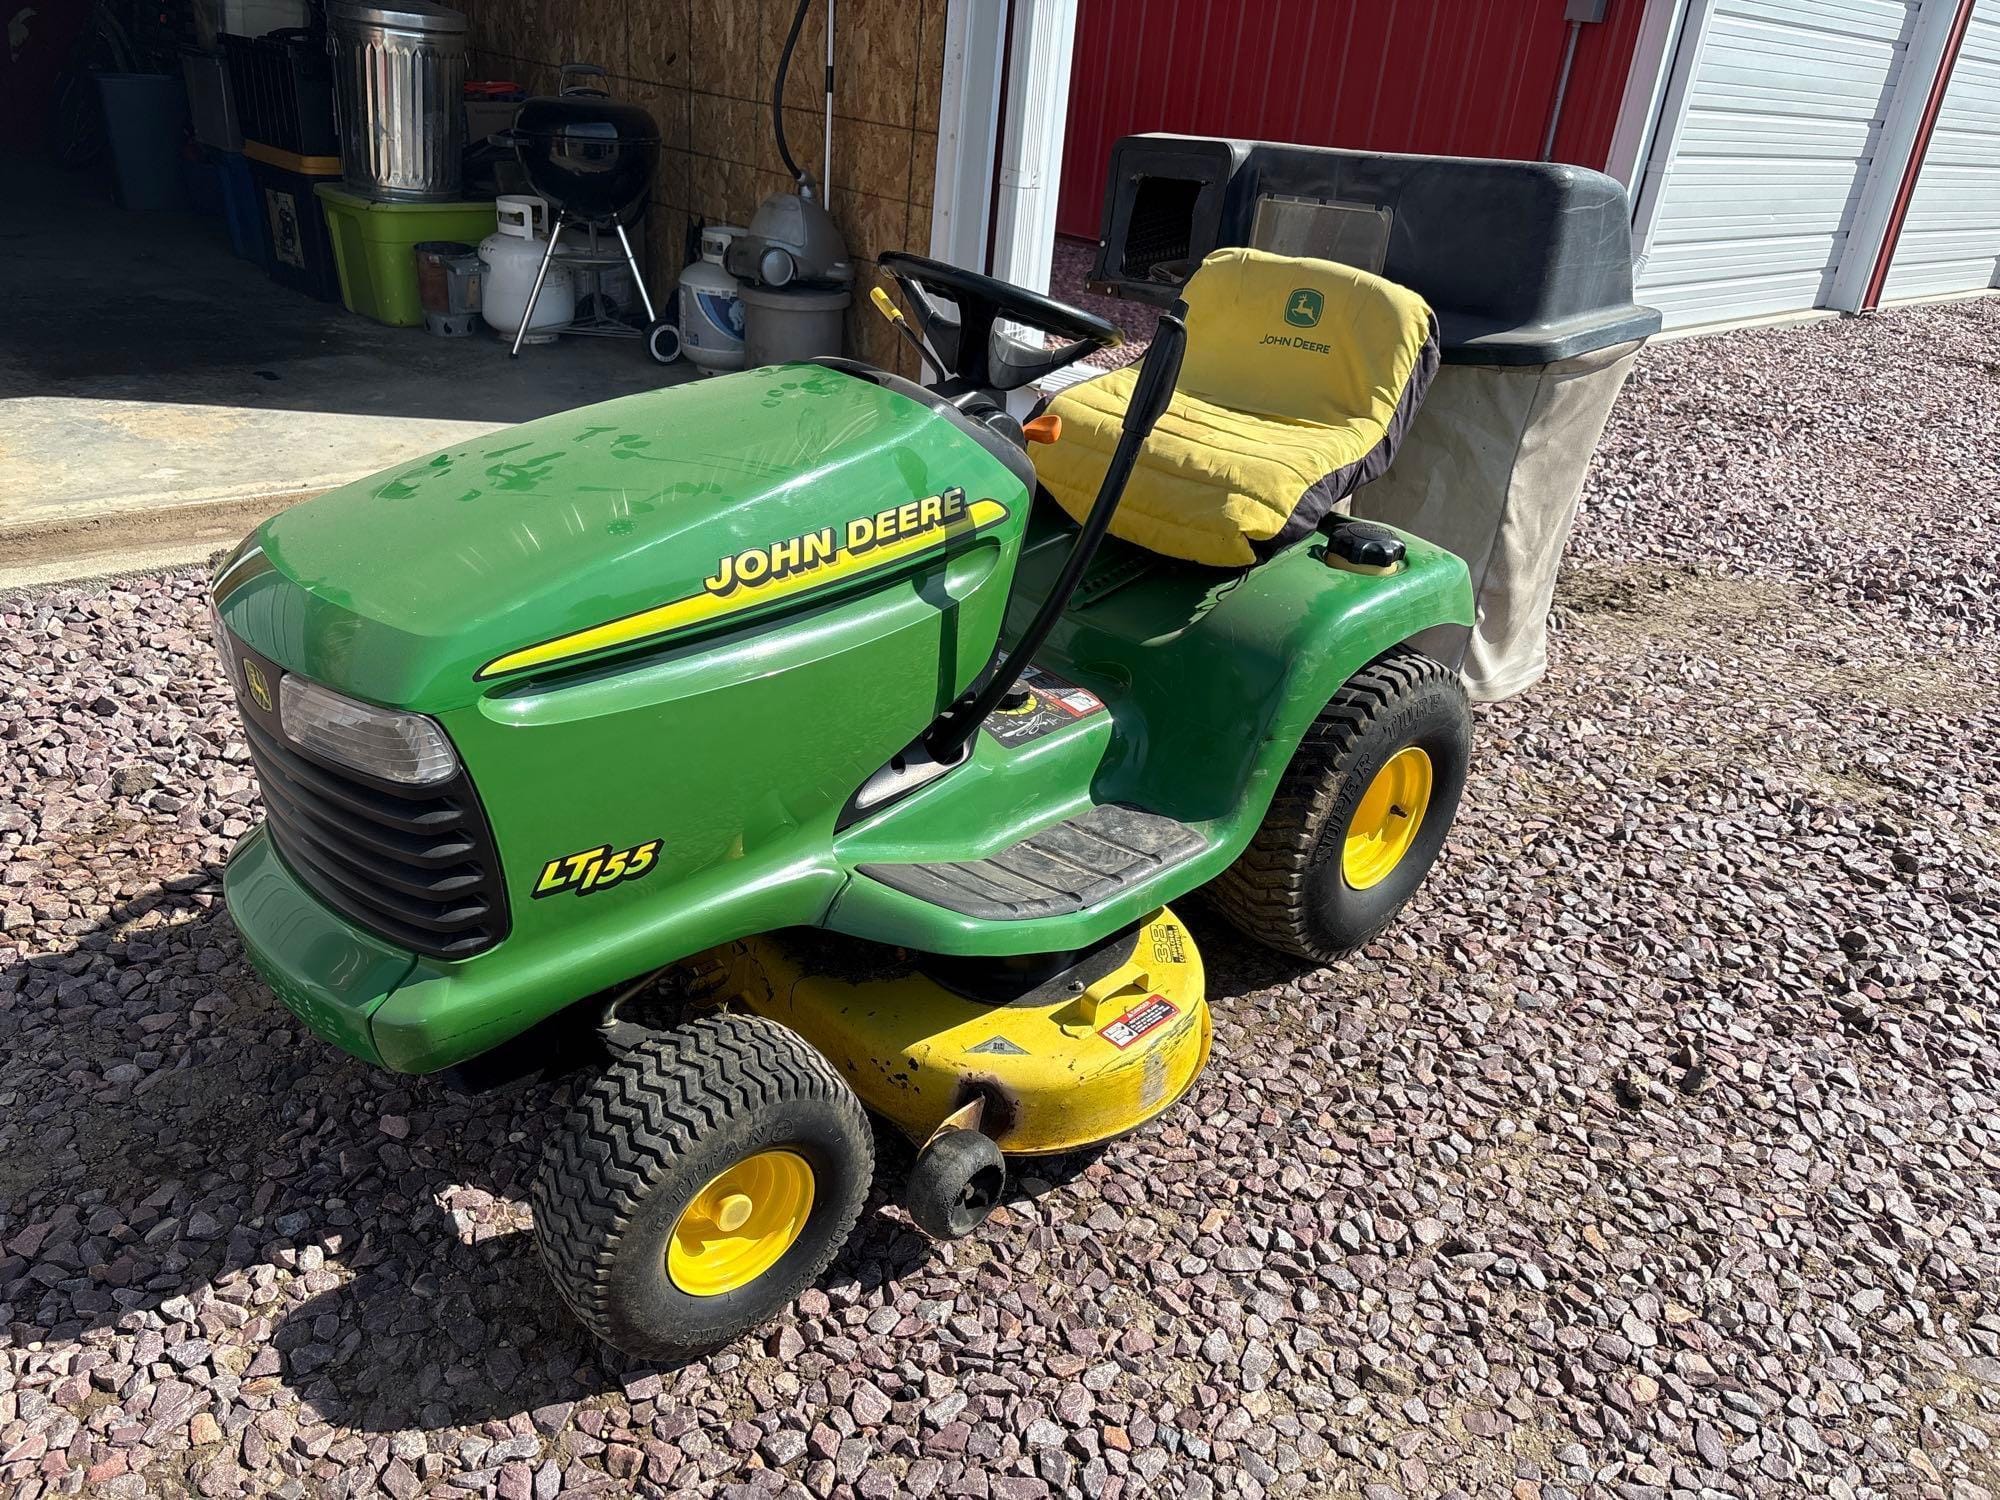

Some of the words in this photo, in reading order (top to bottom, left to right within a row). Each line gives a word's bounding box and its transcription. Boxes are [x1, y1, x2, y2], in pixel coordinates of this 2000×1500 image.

[1259, 334, 1292, 348] JOHN
[1293, 337, 1331, 354] DEERE
[704, 527, 836, 597] JOHN
[846, 487, 966, 554] DEERE
[1311, 751, 1374, 867] SUPER
[530, 837, 666, 900] LT155
[1150, 924, 1173, 963] 38
[669, 1122, 771, 1204] TITAN
